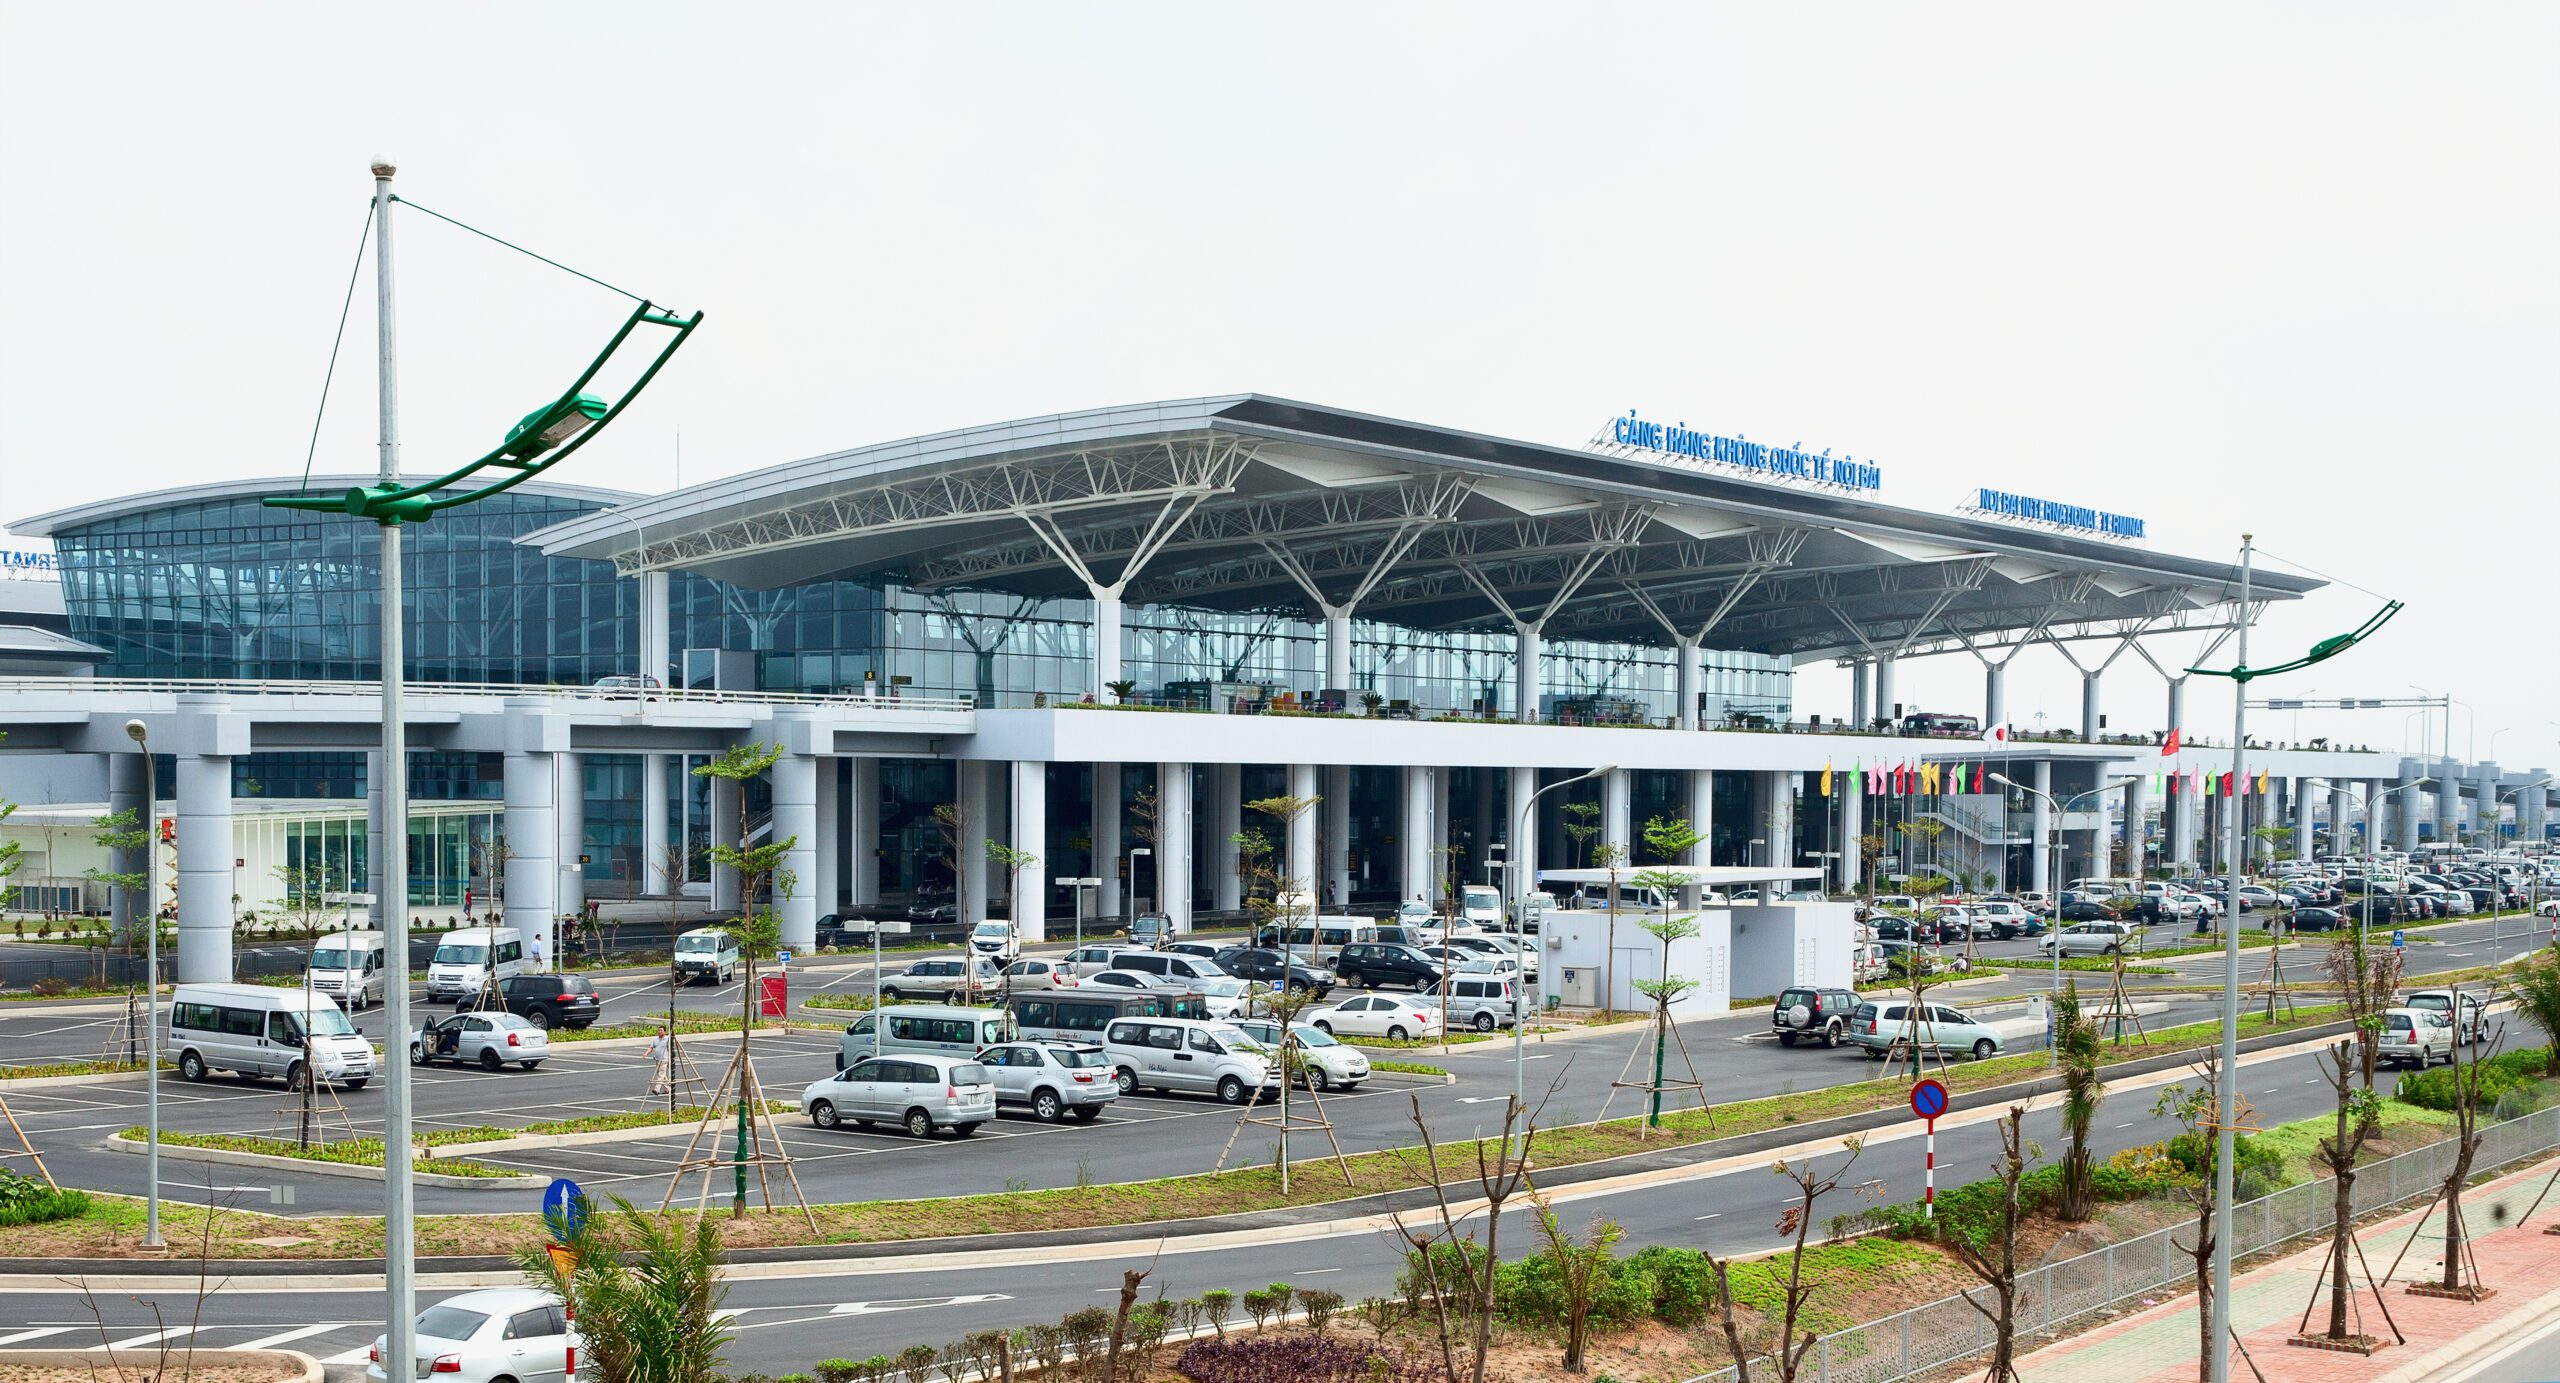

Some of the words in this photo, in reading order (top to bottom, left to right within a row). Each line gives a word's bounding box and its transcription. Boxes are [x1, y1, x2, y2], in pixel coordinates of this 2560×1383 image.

[1616, 409, 1664, 451] CẢNG
[1666, 422, 1711, 460] HÀNG
[1713, 433, 1768, 470] KHÔNG
[1769, 441, 1810, 478] QUỐC
[1812, 447, 1831, 481] TẾ
[1832, 455, 1857, 490] NỘI
[1858, 459, 1881, 490] BÀI
[2021, 496, 2097, 529] INTERNATIONAL
[2099, 511, 2146, 538] TERMINAL
